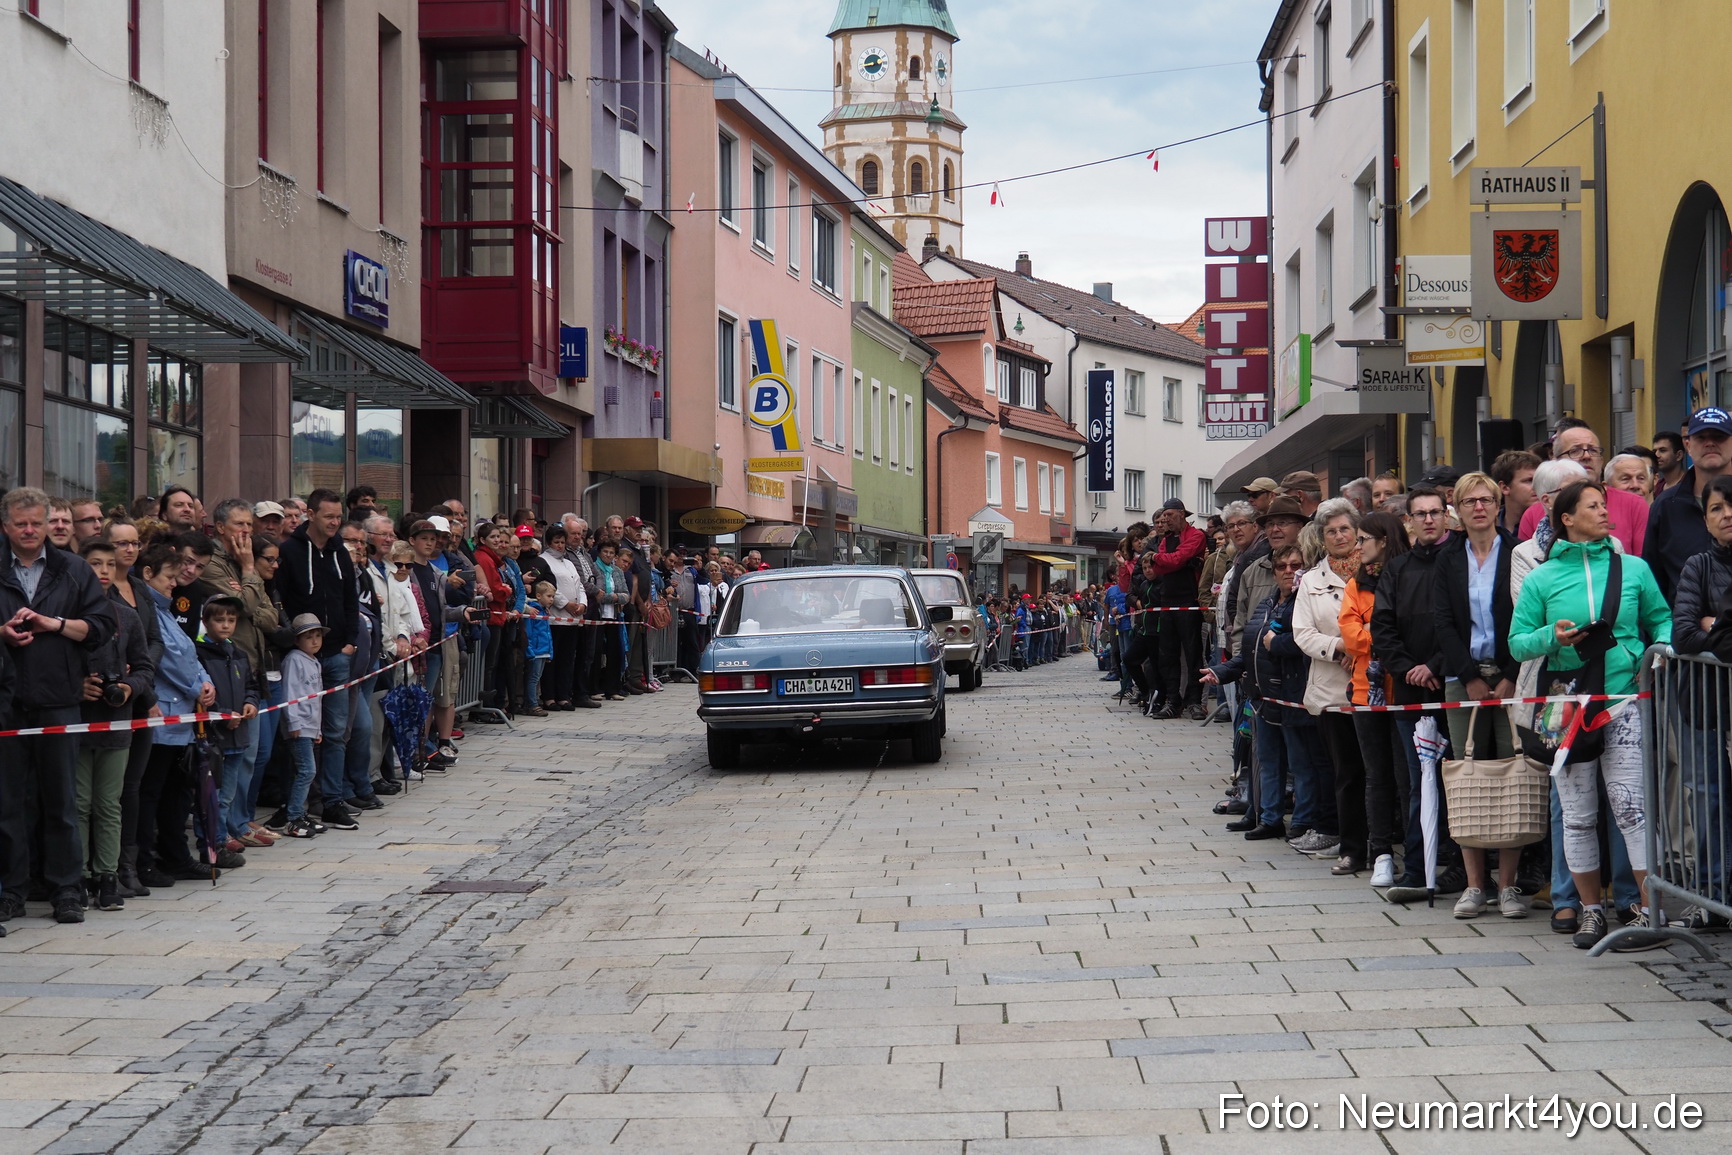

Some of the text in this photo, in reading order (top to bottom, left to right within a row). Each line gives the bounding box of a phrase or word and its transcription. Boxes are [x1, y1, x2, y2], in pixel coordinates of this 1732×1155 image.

[1481, 176, 1570, 193] RATHAUS II
[255, 258, 289, 286] Klostergasse
[354, 258, 388, 304] CECIL
[1207, 220, 1251, 389] WITT
[1411, 353, 1435, 361] Endlich
[1414, 368, 1425, 384] K
[753, 386, 779, 413] B
[1207, 402, 1266, 422] WITT
[304, 413, 334, 447] CECIL
[1105, 380, 1113, 481] TOM TAILOR
[479, 457, 497, 484] CECIL
[751, 460, 794, 468] KLOSTERGASSE
[977, 522, 1006, 531] Creppresso
[785, 678, 852, 693] CHA CA 42H
